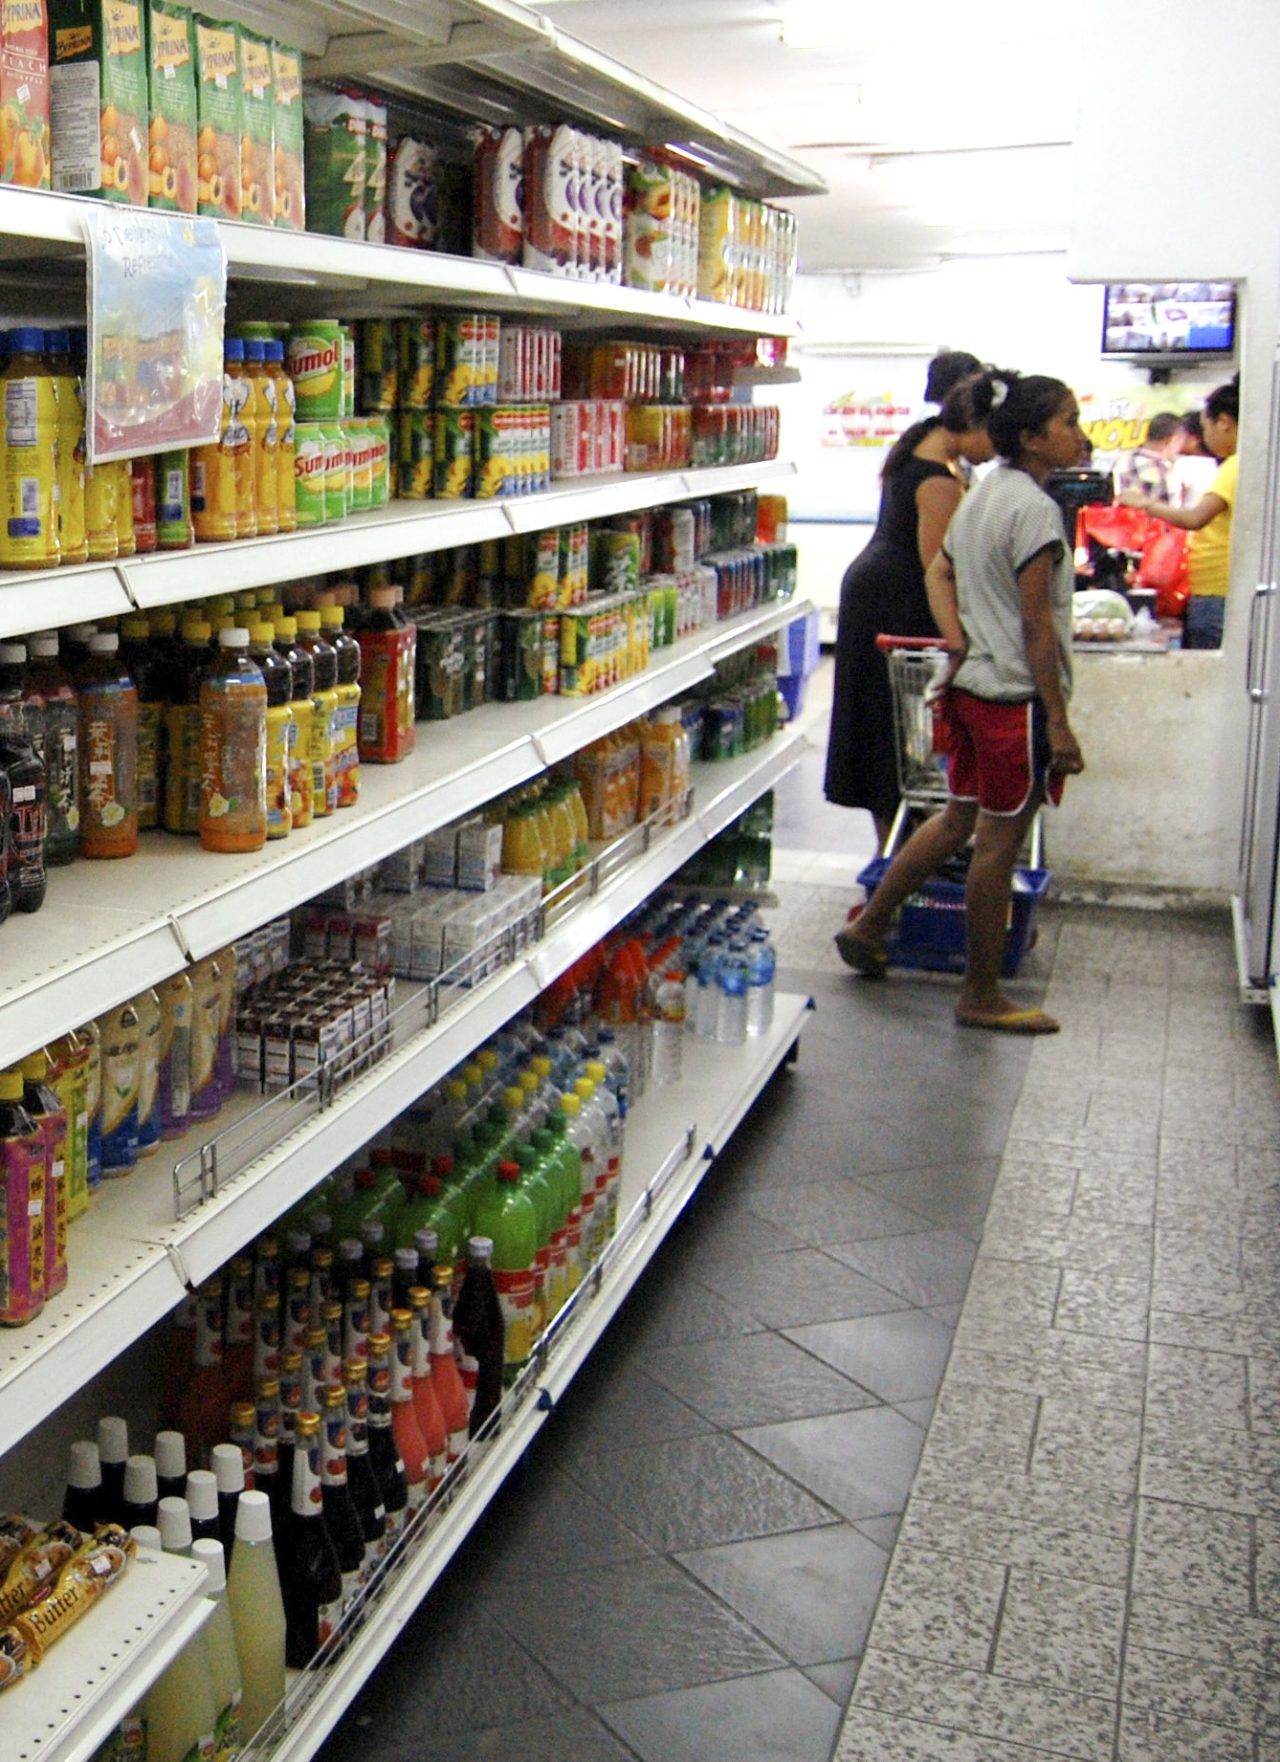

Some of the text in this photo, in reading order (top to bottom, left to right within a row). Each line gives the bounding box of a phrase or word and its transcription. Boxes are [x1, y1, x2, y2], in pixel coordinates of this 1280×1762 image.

[1, 52, 47, 73] PEACH
[291, 340, 339, 376] umol
[31, 1583, 81, 1635] Butter
